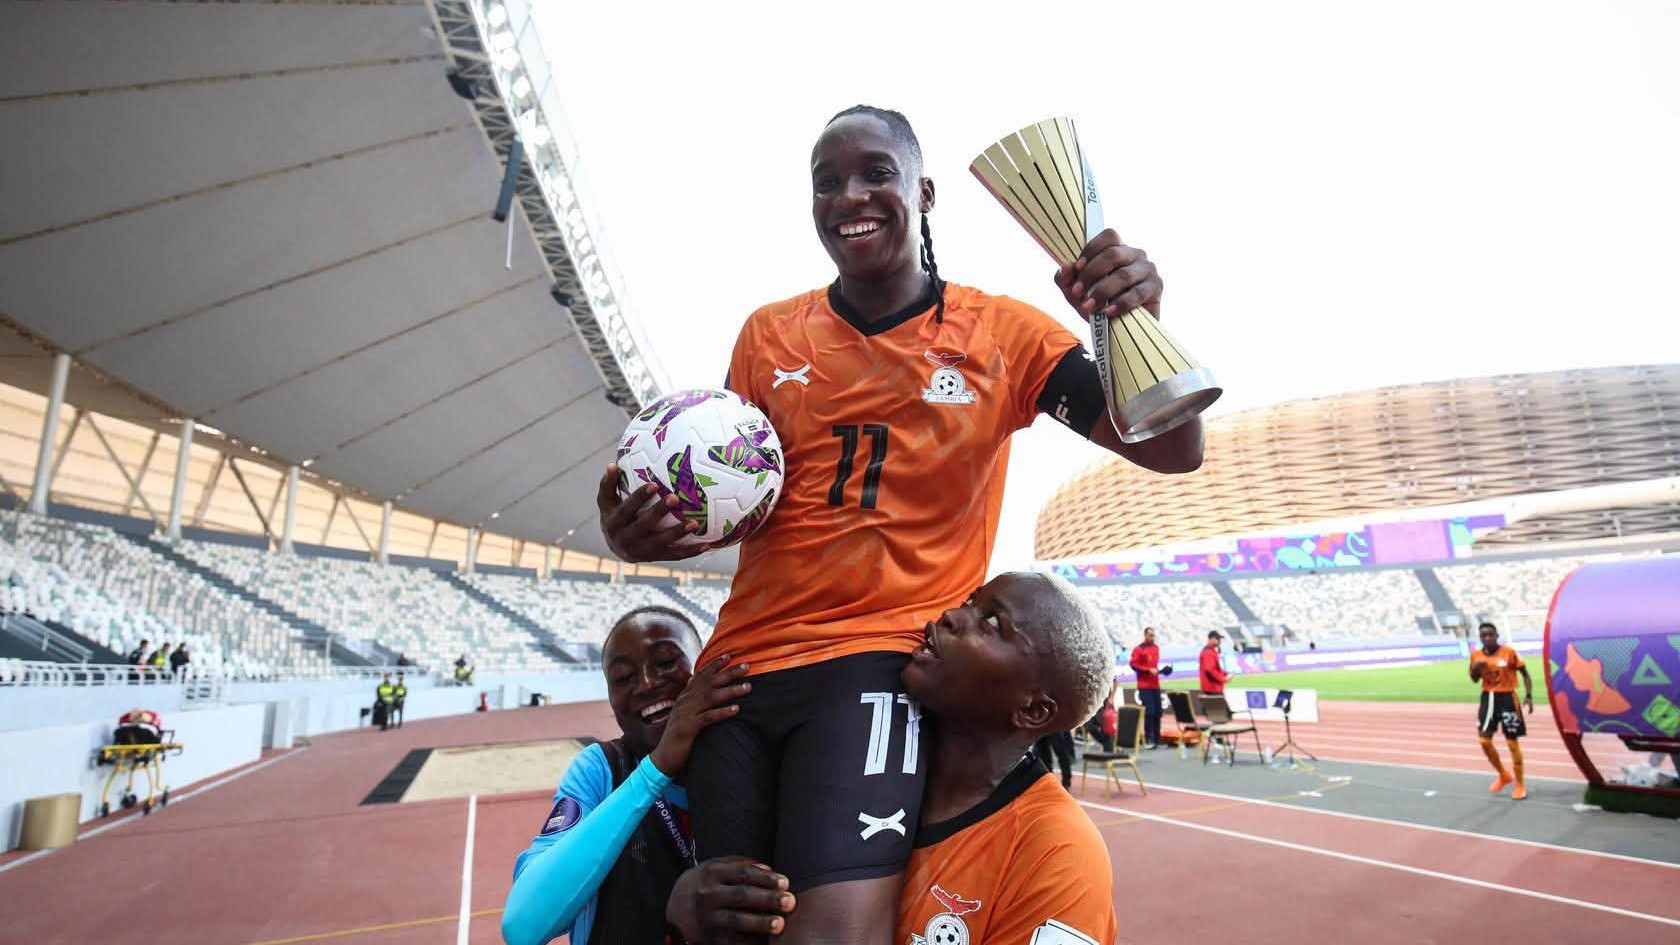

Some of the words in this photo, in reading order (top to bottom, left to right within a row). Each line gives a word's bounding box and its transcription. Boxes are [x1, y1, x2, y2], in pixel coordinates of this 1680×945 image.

[828, 424, 889, 509] 11
[861, 692, 921, 775] 11
[667, 821, 691, 858] NATIONS
